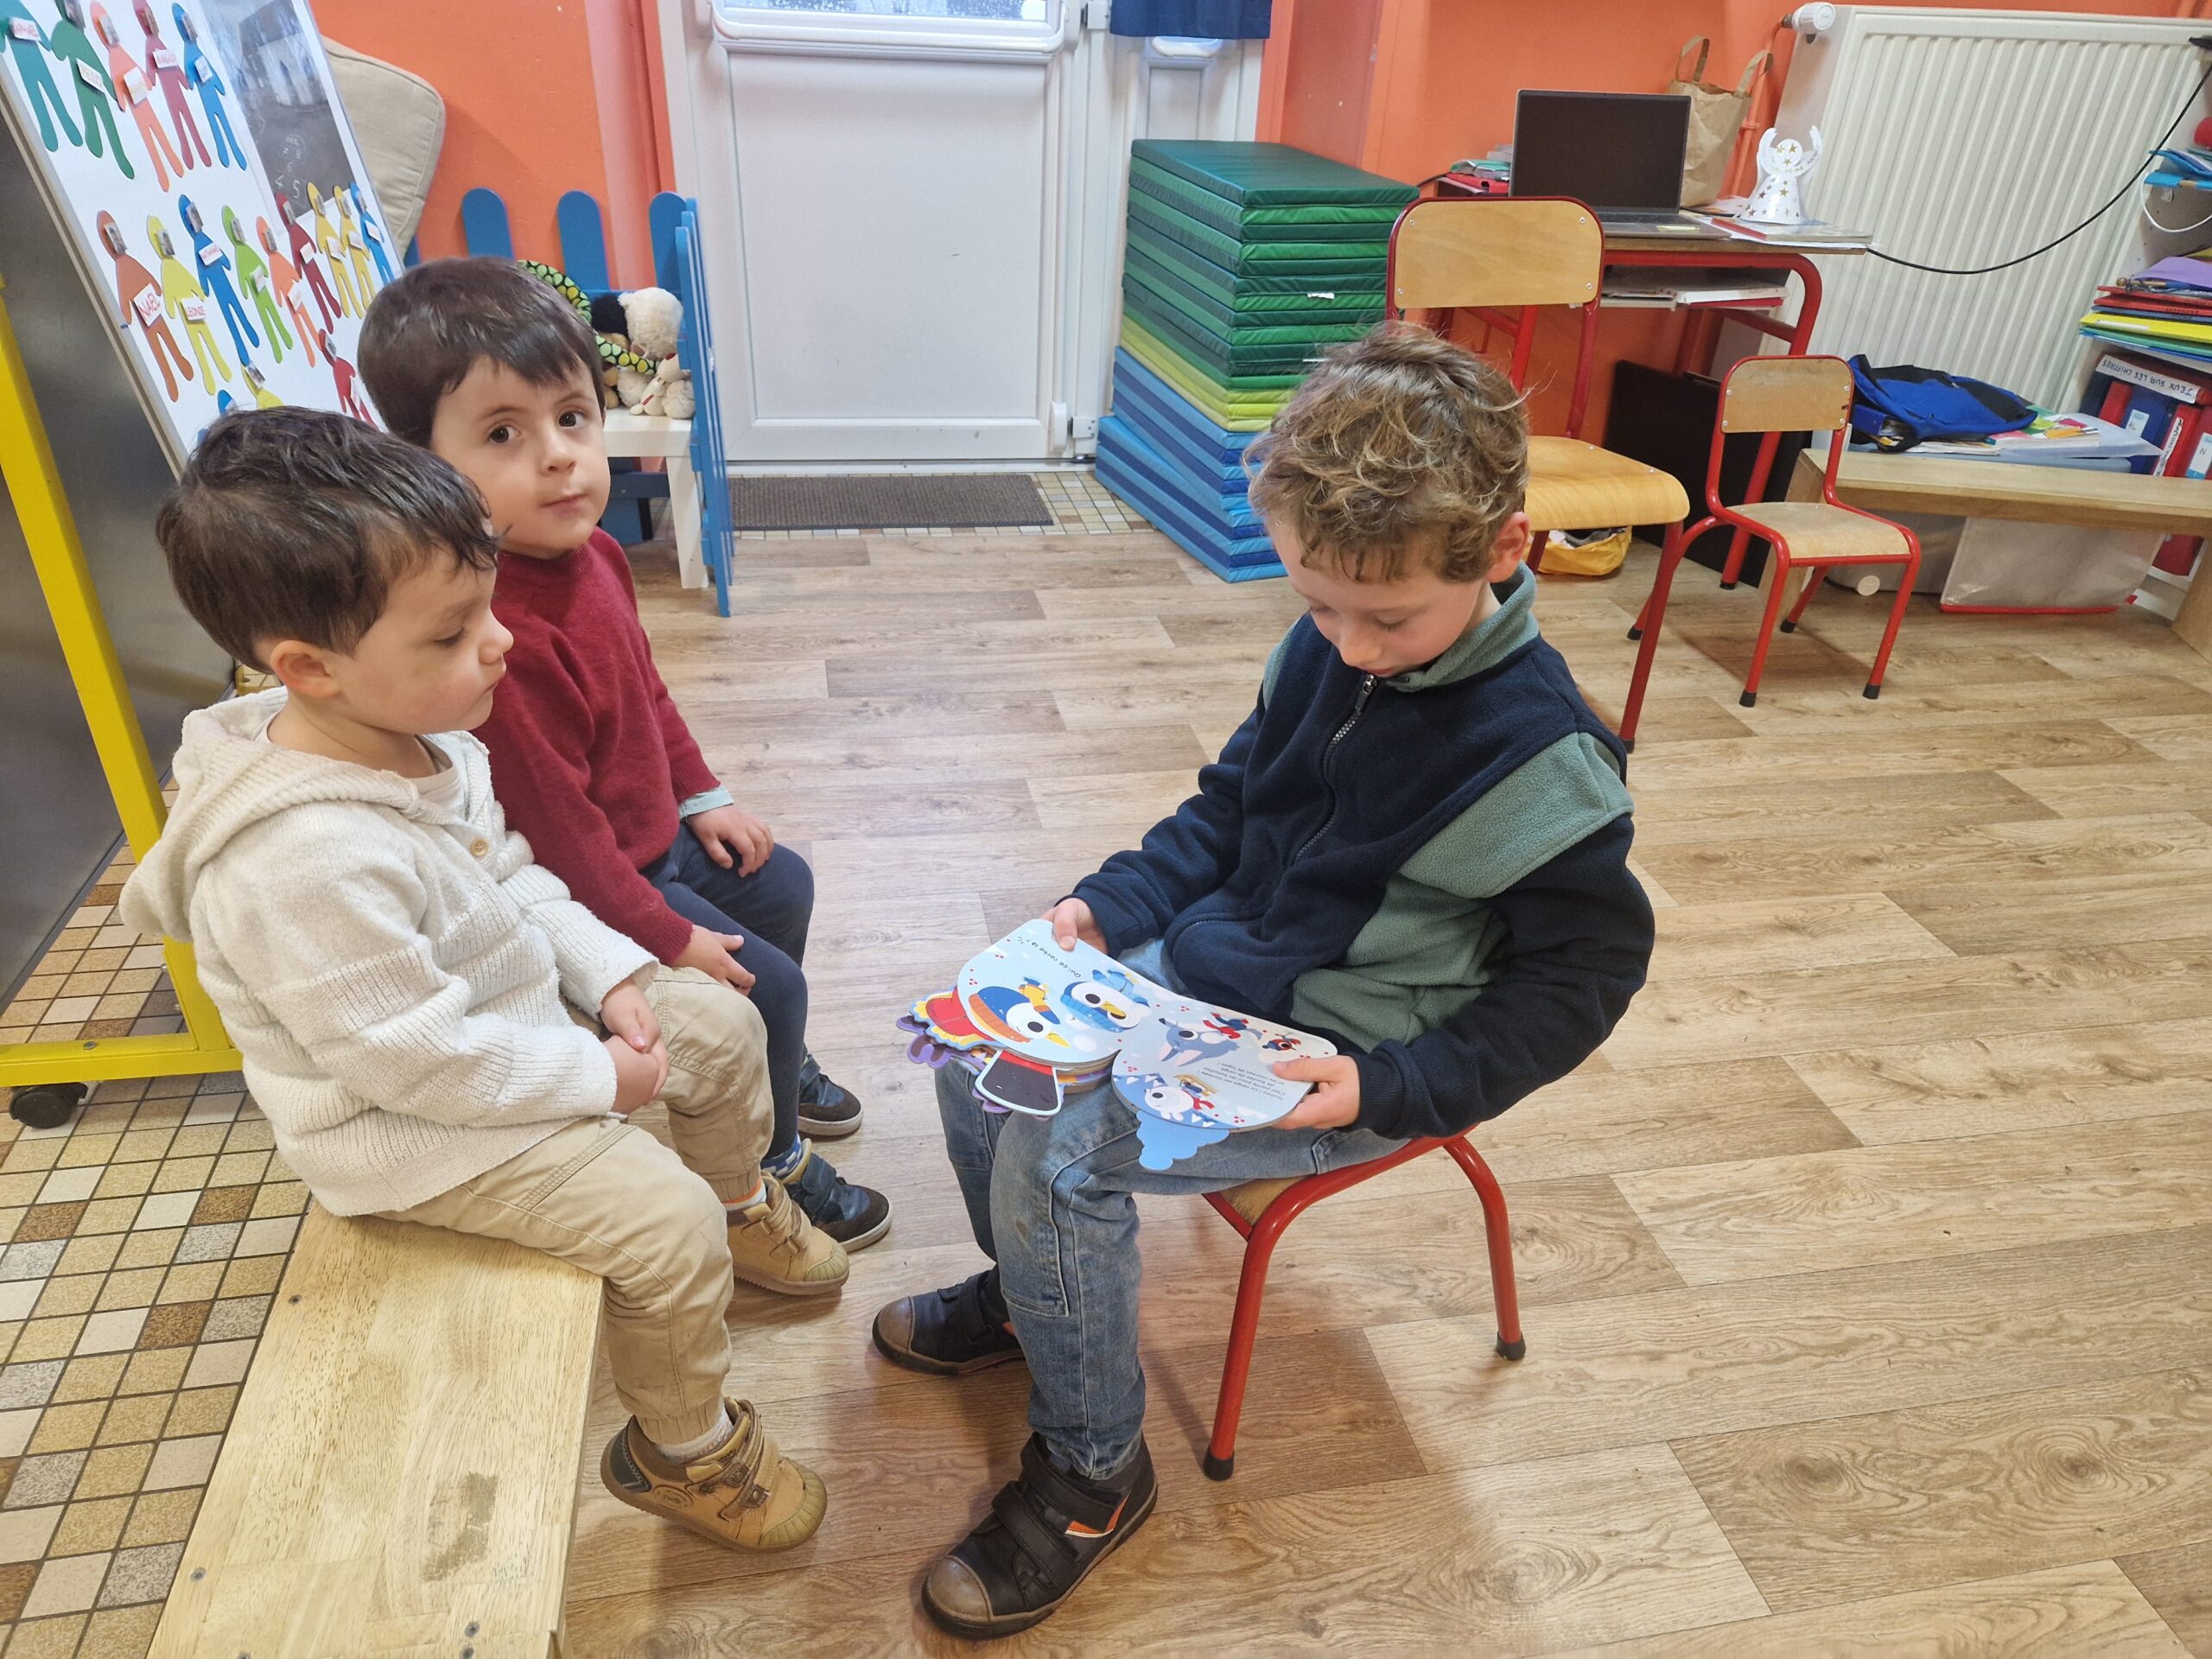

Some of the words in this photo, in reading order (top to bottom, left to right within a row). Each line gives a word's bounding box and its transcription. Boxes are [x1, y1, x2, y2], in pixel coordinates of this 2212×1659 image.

[293, 180, 301, 199] 5
[2102, 359, 2133, 375] CHIFFRES
[2134, 371, 2149, 382] LES
[2150, 378, 2166, 388] SUR
[2169, 382, 2194, 397] JEUX
